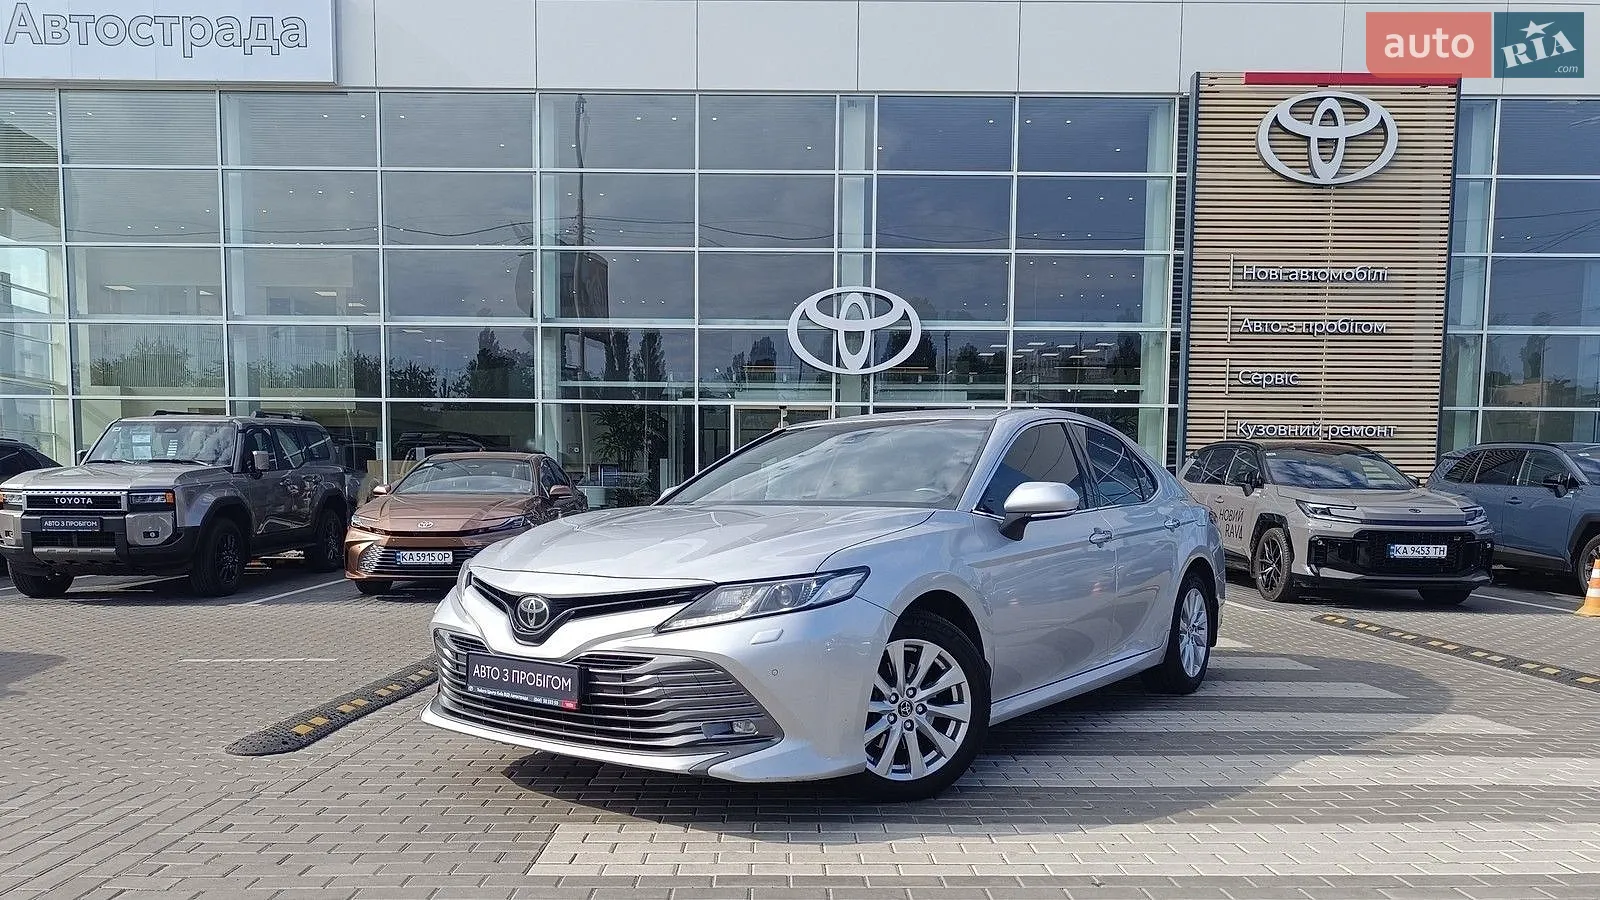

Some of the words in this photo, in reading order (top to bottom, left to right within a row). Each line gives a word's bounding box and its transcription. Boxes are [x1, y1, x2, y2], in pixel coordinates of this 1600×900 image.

[4, 2, 308, 58] Автострада
[1242, 264, 1283, 281] Нові
[1289, 265, 1390, 281] автомобілі
[1240, 318, 1281, 333] Авто
[1286, 321, 1297, 333] з
[1302, 318, 1387, 337] пробігом
[1238, 369, 1300, 388] Сервіс
[1235, 420, 1323, 439] Кузовний
[1328, 425, 1397, 440] ремонт
[1219, 508, 1244, 522] НОВИЙ
[401, 552, 414, 562] KA
[416, 552, 436, 562] 5915
[437, 552, 451, 562] OP
[1395, 546, 1408, 555] KA
[1410, 546, 1431, 555] 9453
[1433, 546, 1445, 555] TH
[472, 664, 500, 681] АВТО
[502, 668, 509, 682] З
[511, 669, 572, 692] ПРОБІГОМ
